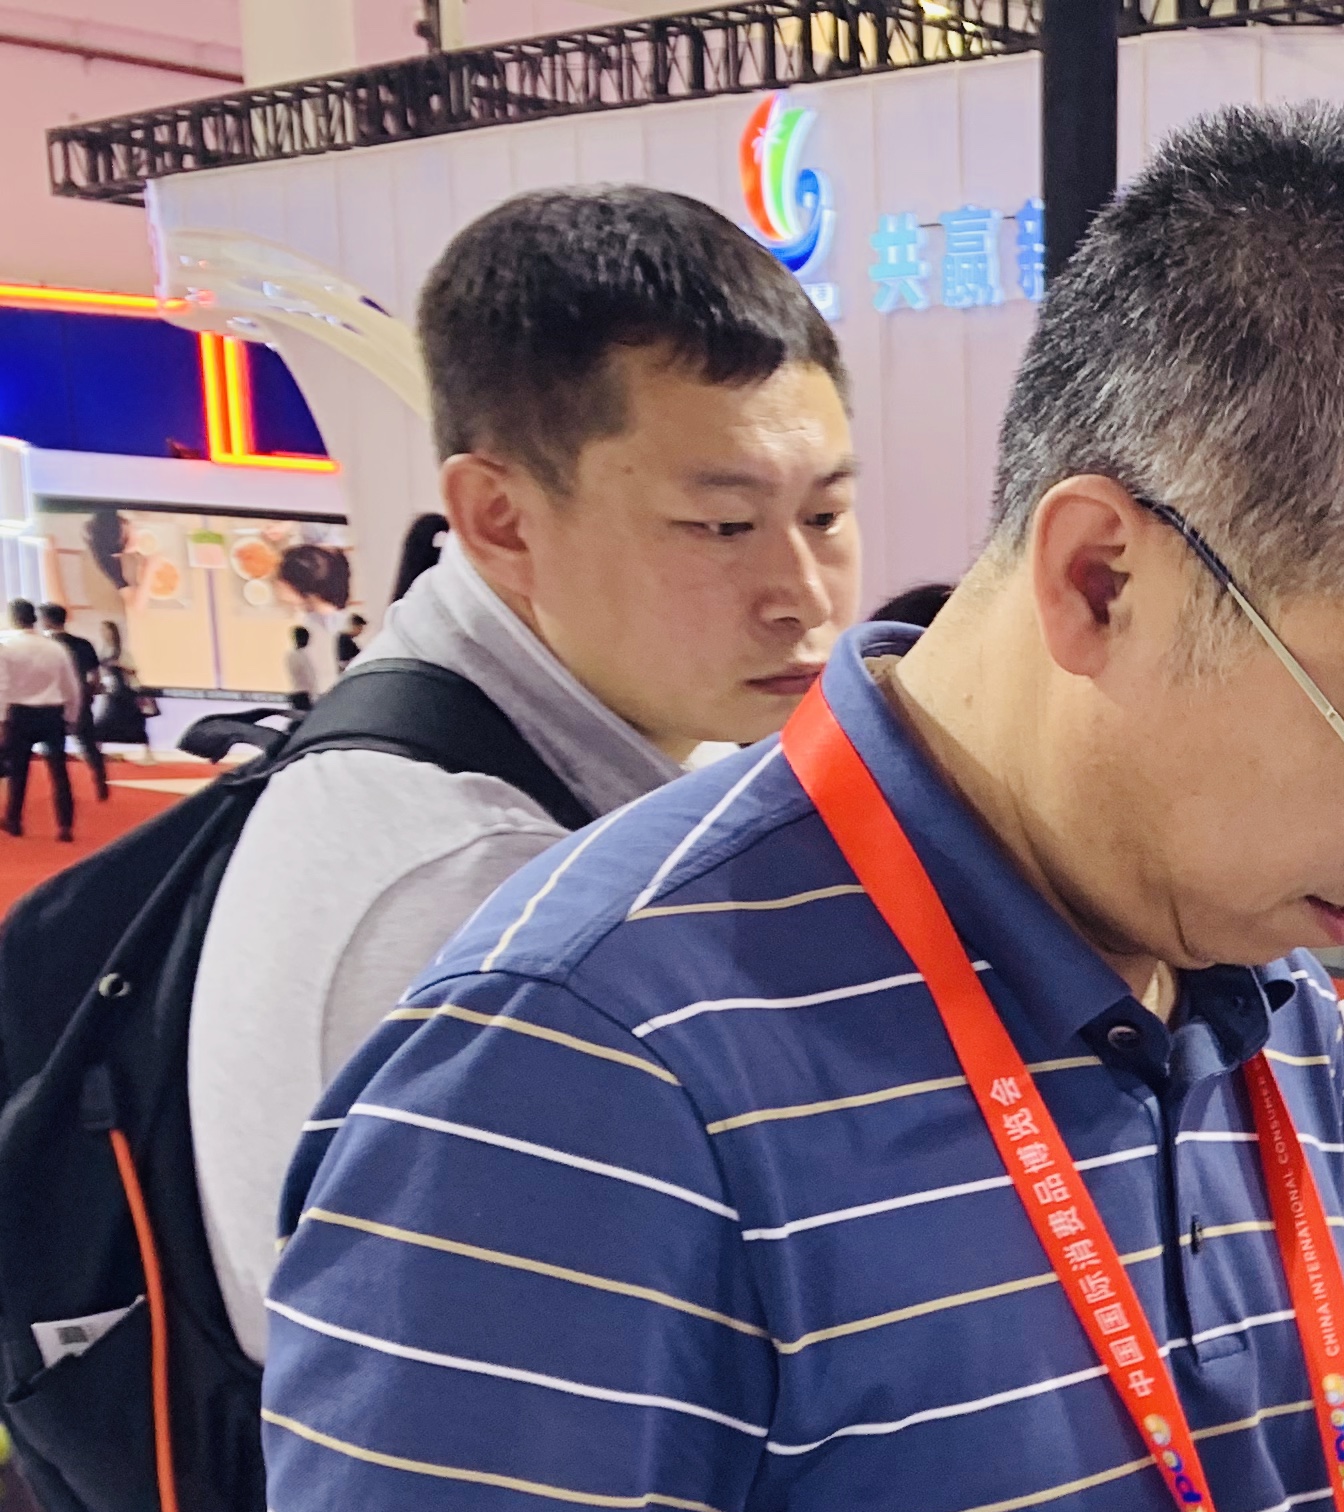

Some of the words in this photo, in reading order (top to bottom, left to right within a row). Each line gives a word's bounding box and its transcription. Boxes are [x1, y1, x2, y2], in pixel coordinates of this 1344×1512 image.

[990, 1076, 1156, 1398] 中国国际消费品博览会
[1282, 1170, 1332, 1298] INTERNATIONAL
[1314, 1300, 1340, 1357] CHINA
